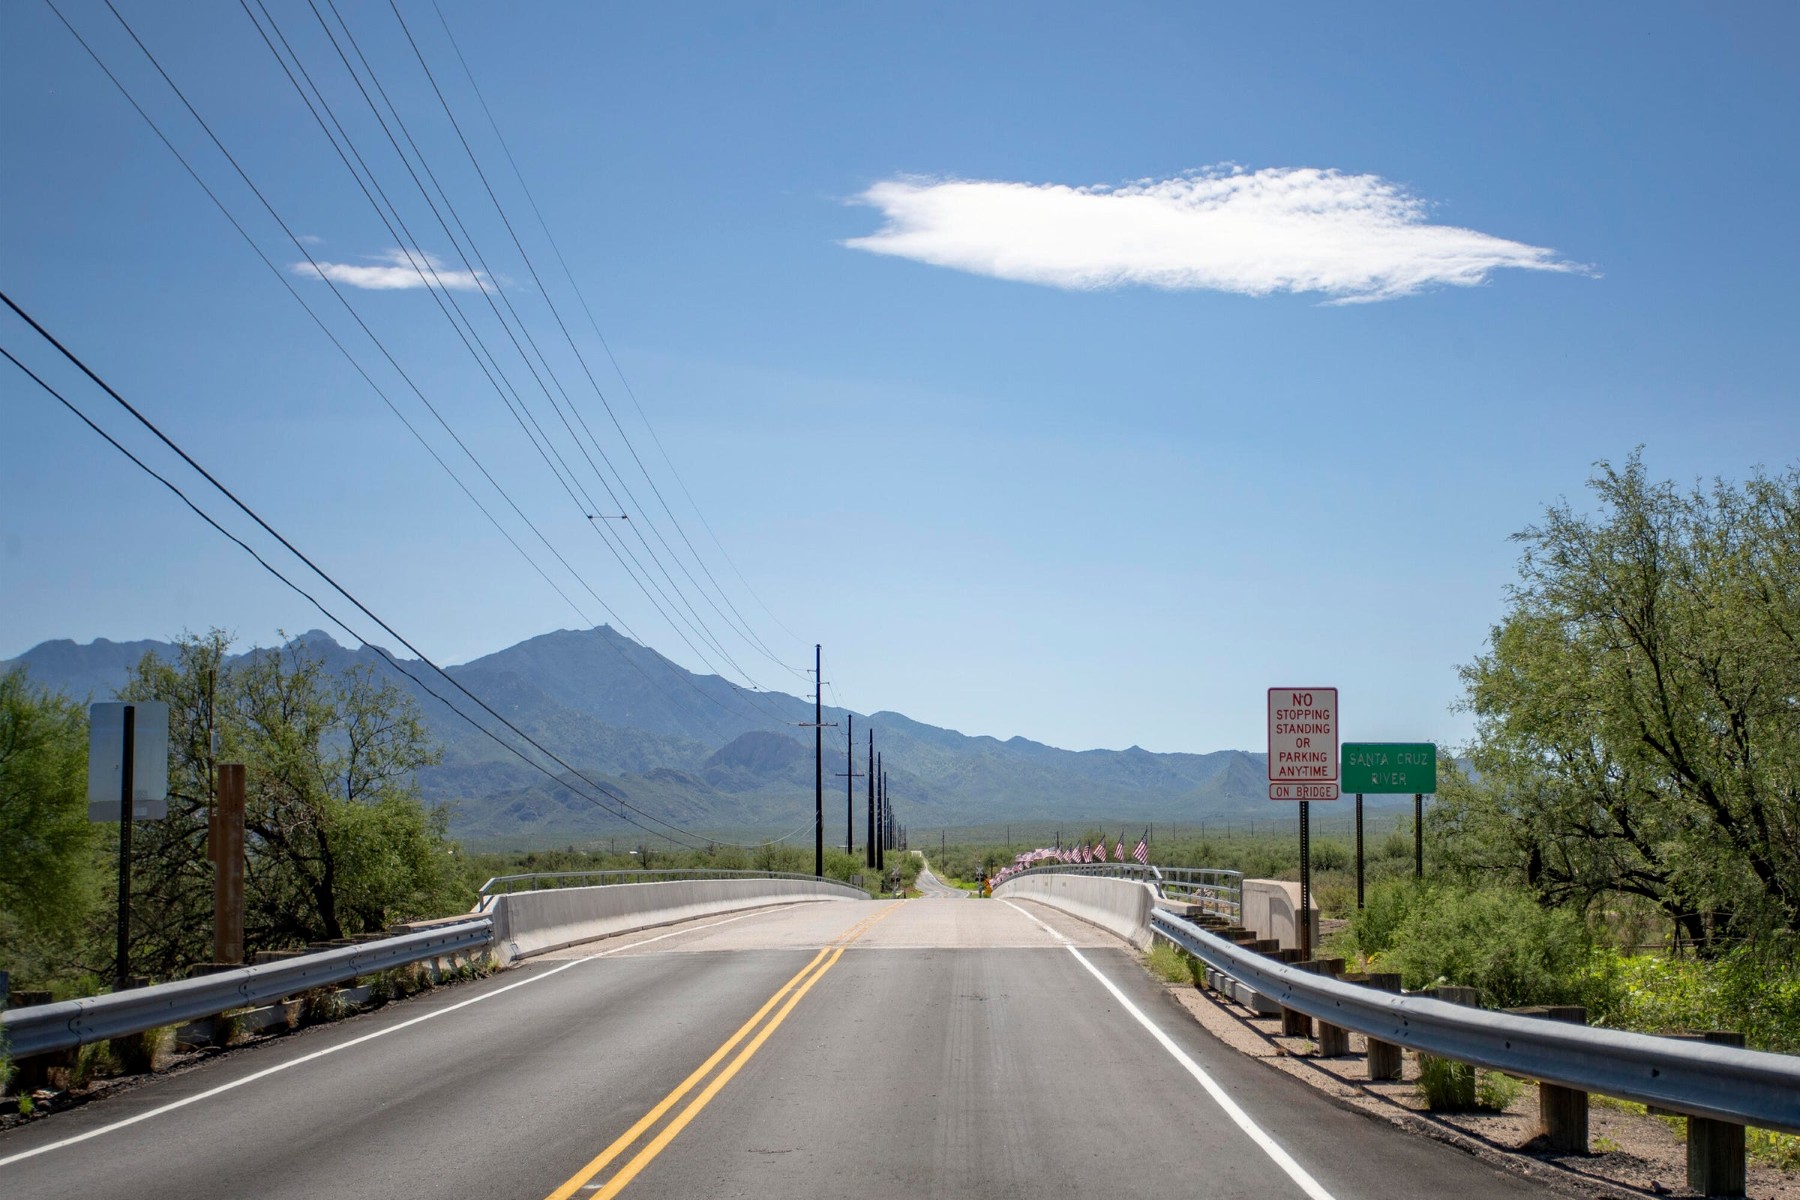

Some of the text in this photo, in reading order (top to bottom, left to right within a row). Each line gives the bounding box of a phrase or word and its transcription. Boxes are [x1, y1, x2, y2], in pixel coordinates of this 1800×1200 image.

[1292, 693, 1313, 707] NO
[1276, 709, 1330, 720] STOPPING
[1276, 723, 1330, 734] STANDING
[1295, 738, 1311, 748] OR
[1279, 752, 1327, 762] PARKING
[1349, 752, 1428, 766] SANTA CRUZ
[1279, 766, 1328, 777] ANYTIME
[1371, 772, 1407, 786] RIVER
[1276, 786, 1331, 797] ON BRIDGE
